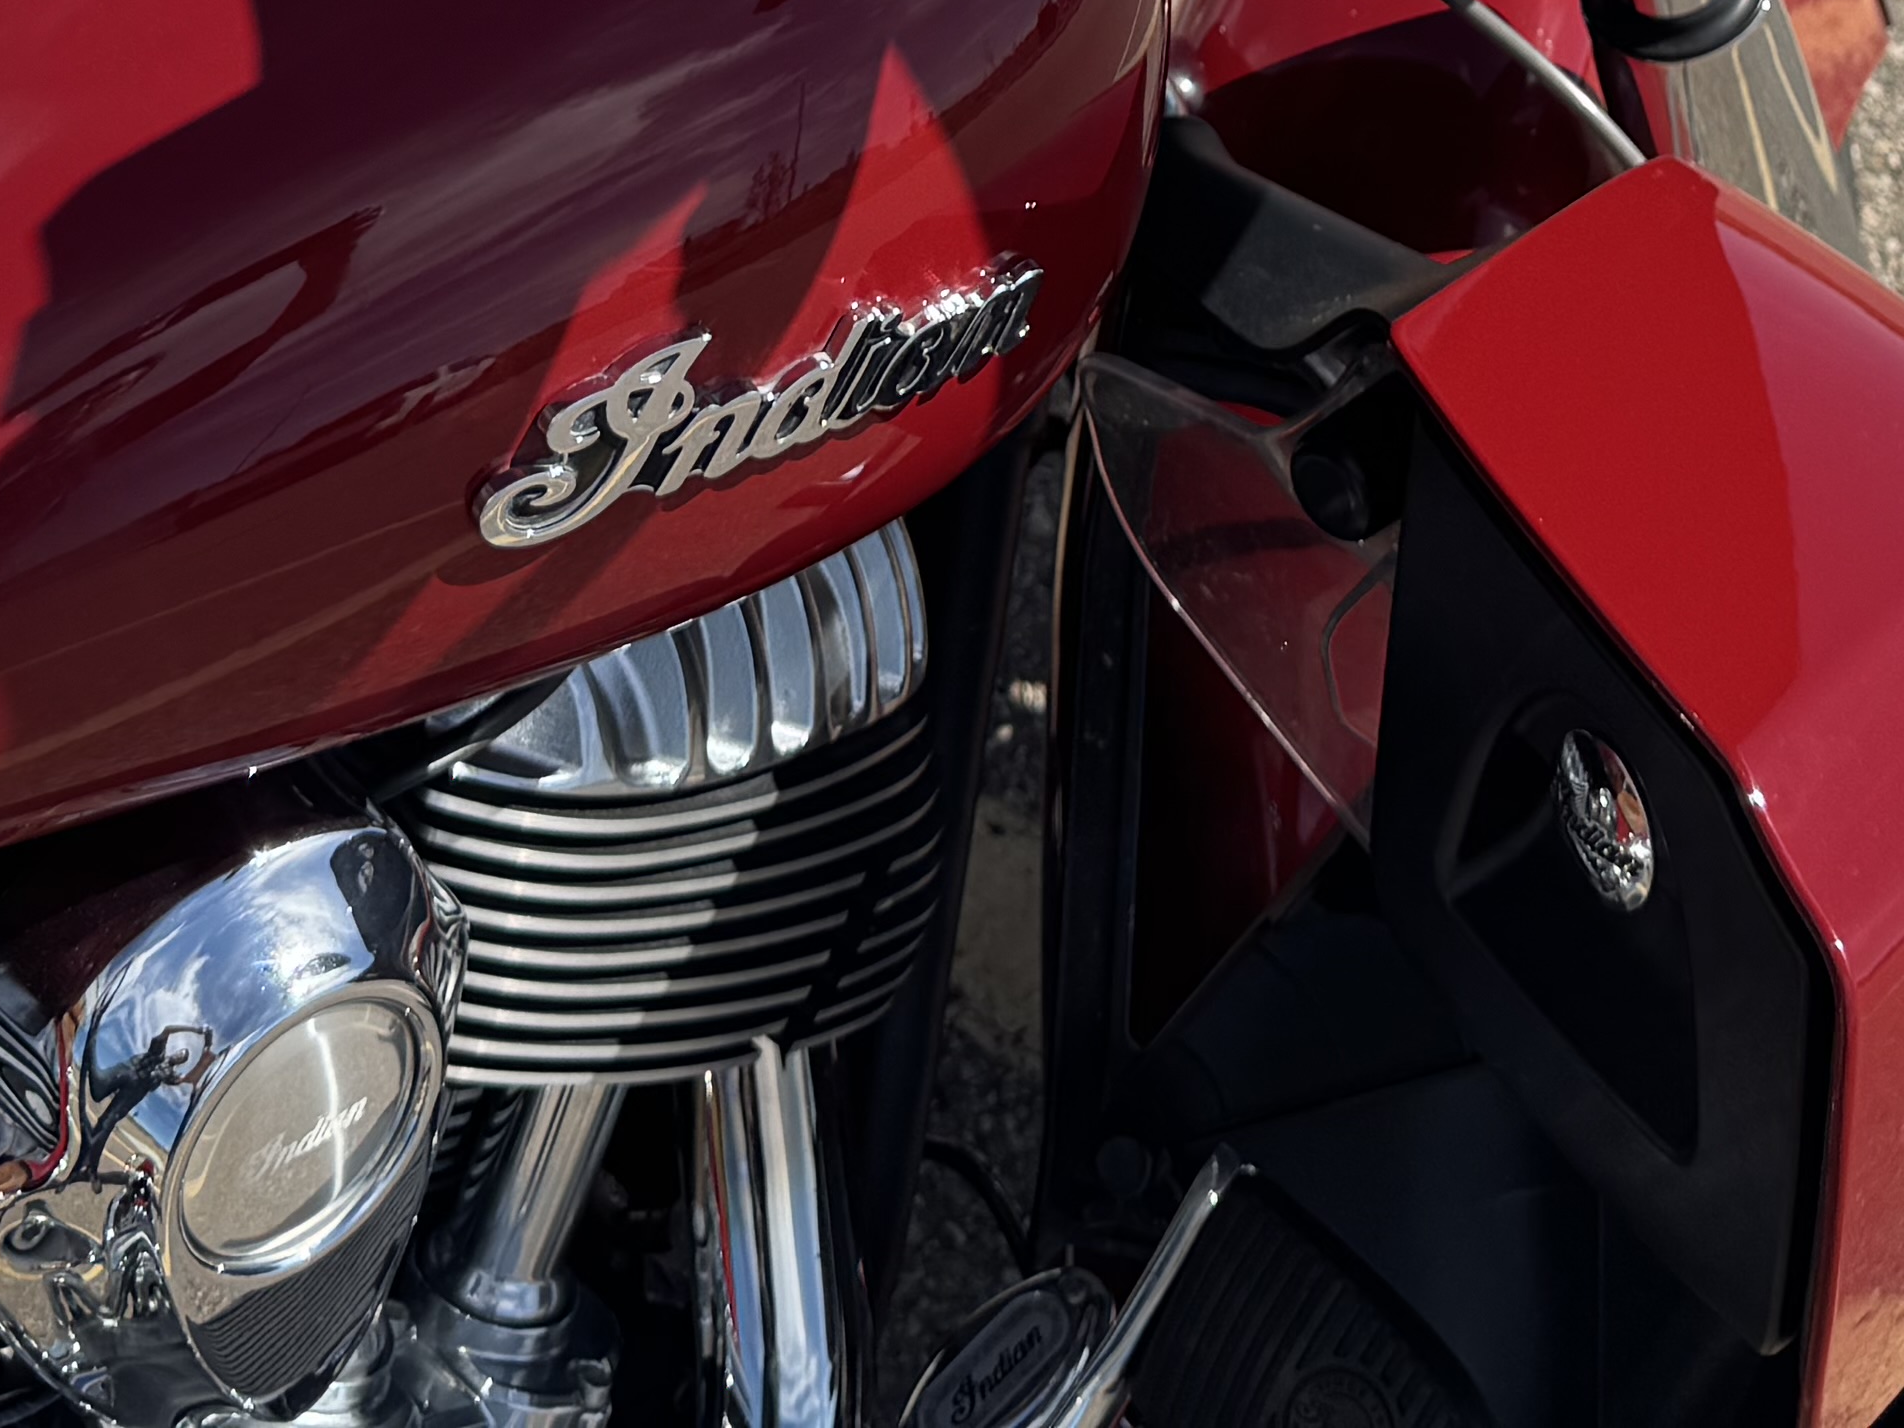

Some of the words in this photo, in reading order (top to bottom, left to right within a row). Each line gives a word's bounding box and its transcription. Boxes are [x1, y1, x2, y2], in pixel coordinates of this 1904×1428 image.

[479, 253, 1044, 548] Indian
[239, 1095, 369, 1182] Indian
[951, 1325, 1043, 1426] Indian
